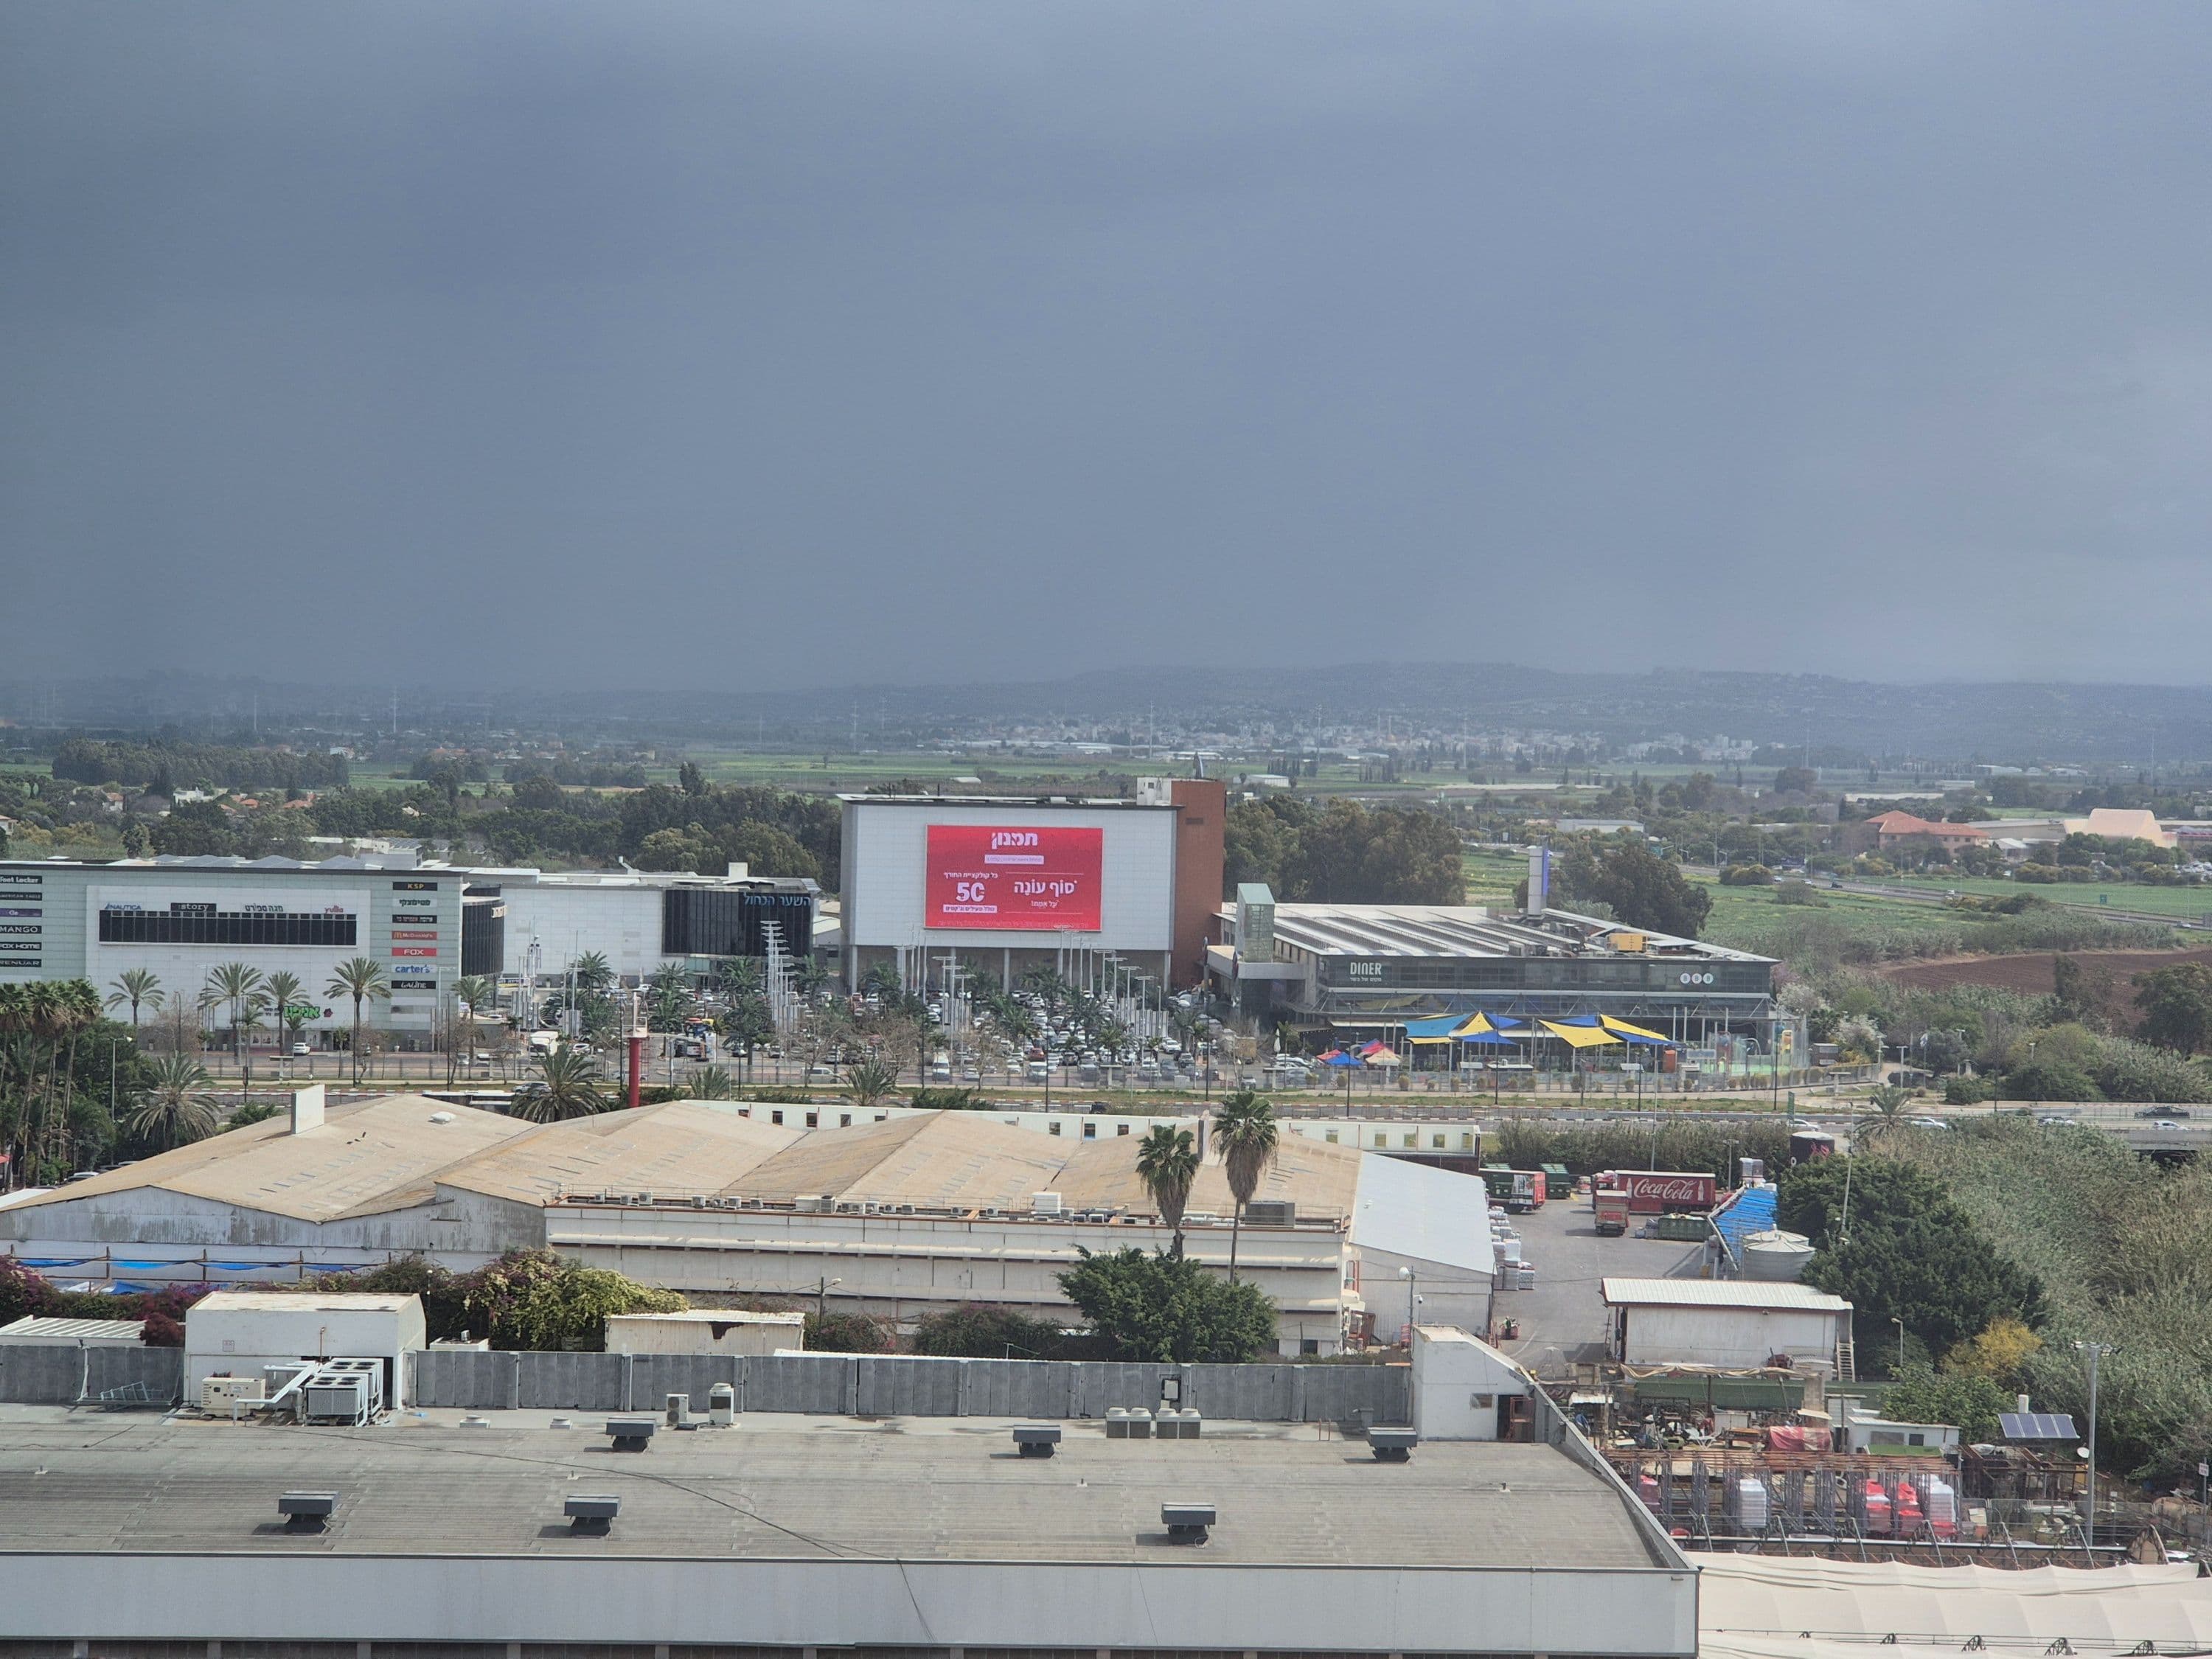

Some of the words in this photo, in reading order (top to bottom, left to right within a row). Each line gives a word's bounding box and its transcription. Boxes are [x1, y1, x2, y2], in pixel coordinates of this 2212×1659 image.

[991, 832, 1038, 850] תמנון
[743, 891, 775, 906] הכחול
[779, 895, 810, 907] השער
[245, 903, 268, 912] ספורט
[395, 964, 430, 973] carter's
[1350, 961, 1382, 975] DINER
